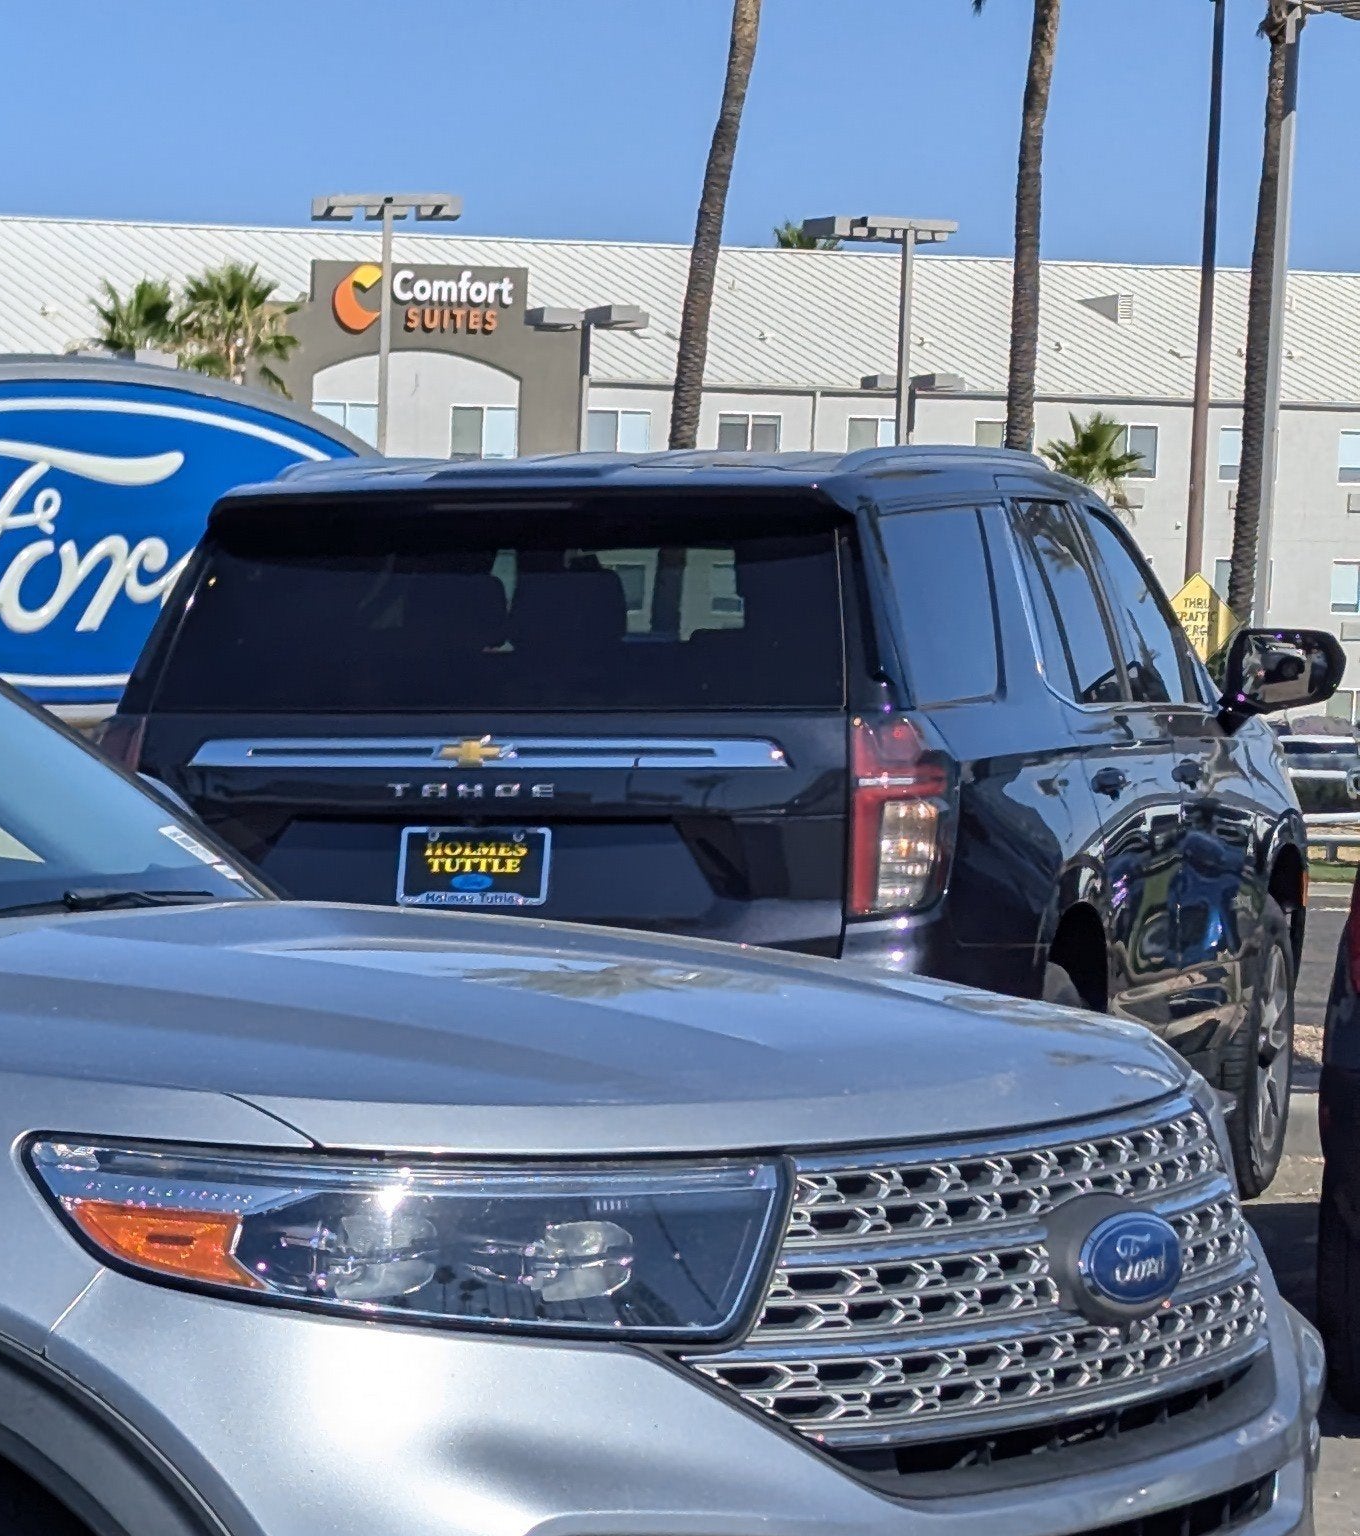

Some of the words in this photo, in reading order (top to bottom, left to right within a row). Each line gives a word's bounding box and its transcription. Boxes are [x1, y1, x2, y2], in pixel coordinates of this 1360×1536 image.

[392, 269, 513, 304] Comfort
[405, 307, 498, 332] SUITES
[387, 783, 555, 798] TAHOE
[424, 842, 529, 857] HOLMES
[427, 857, 522, 873] TUTTLE
[1115, 1233, 1167, 1285] Ford
